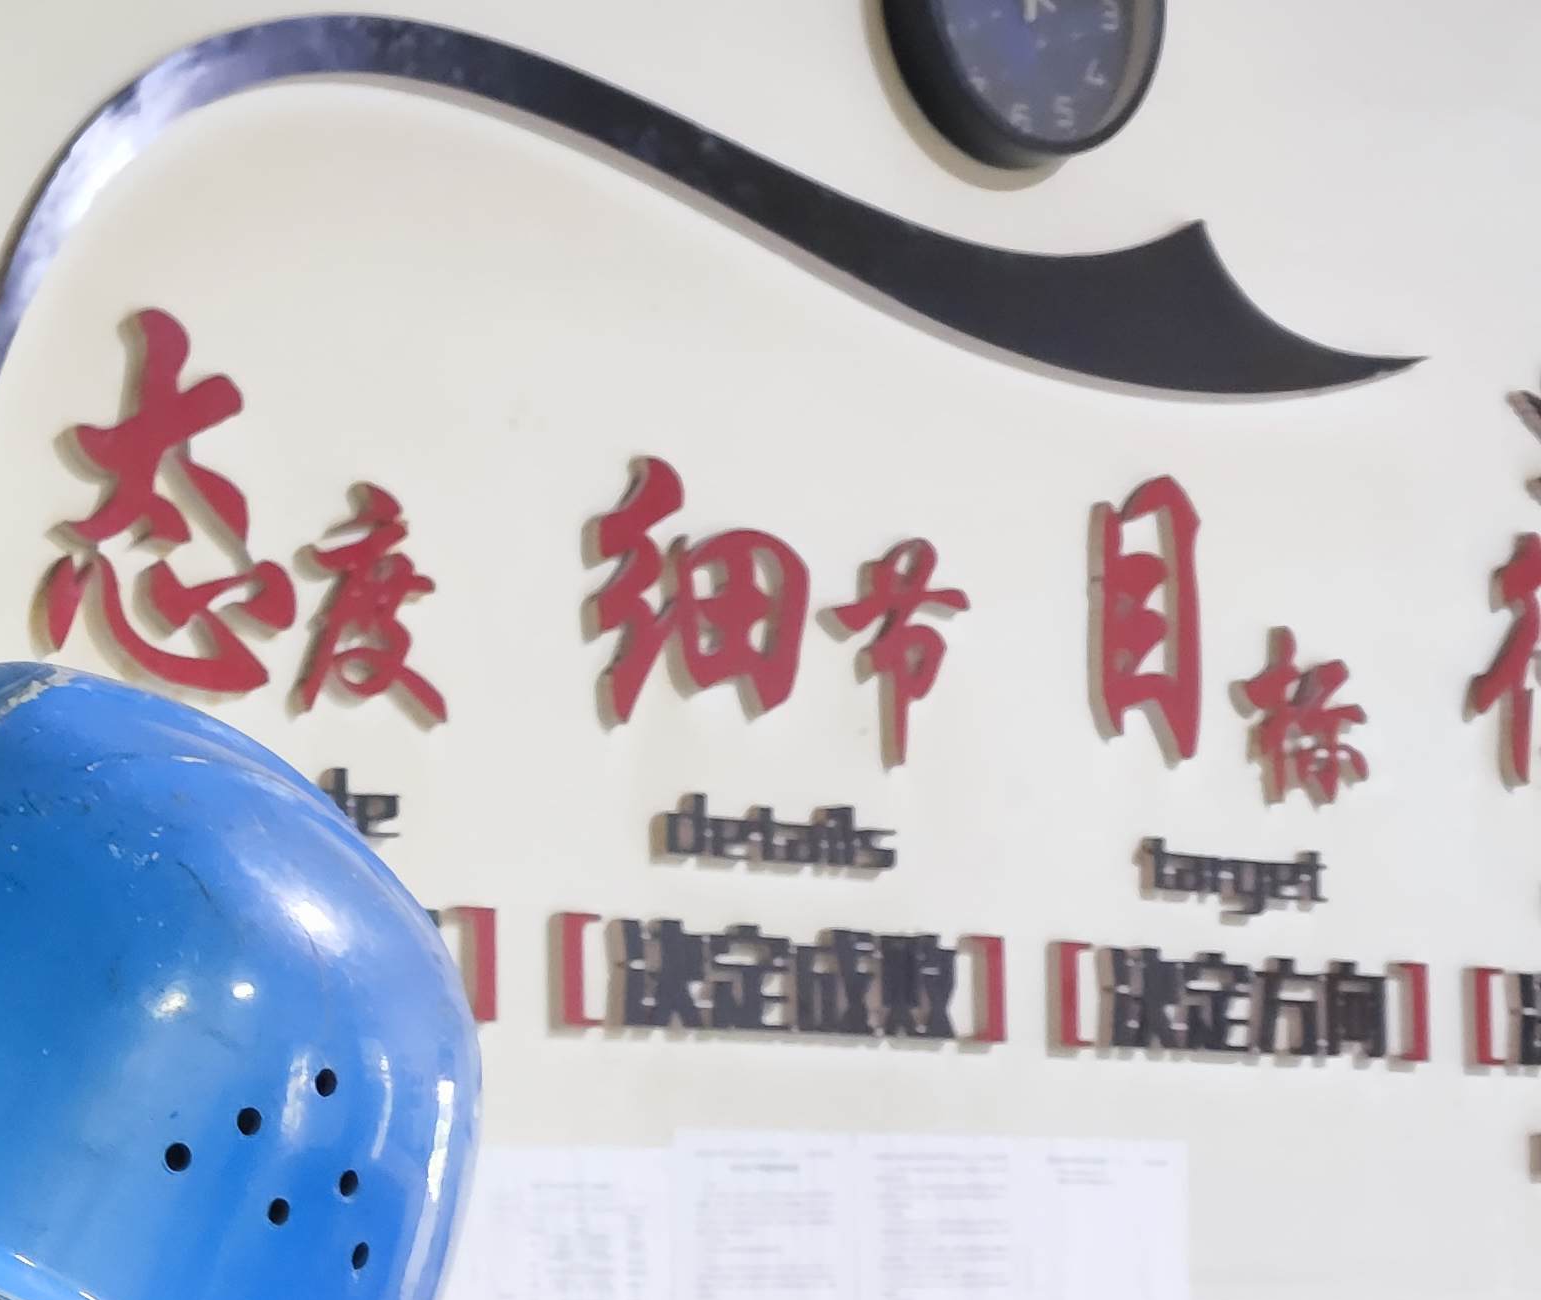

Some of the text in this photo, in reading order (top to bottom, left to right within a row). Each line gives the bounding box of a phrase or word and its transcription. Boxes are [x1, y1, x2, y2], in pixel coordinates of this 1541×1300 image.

[33, 308, 448, 728] 态度
[585, 455, 971, 770] 细节
[1089, 475, 1369, 808] 目标
